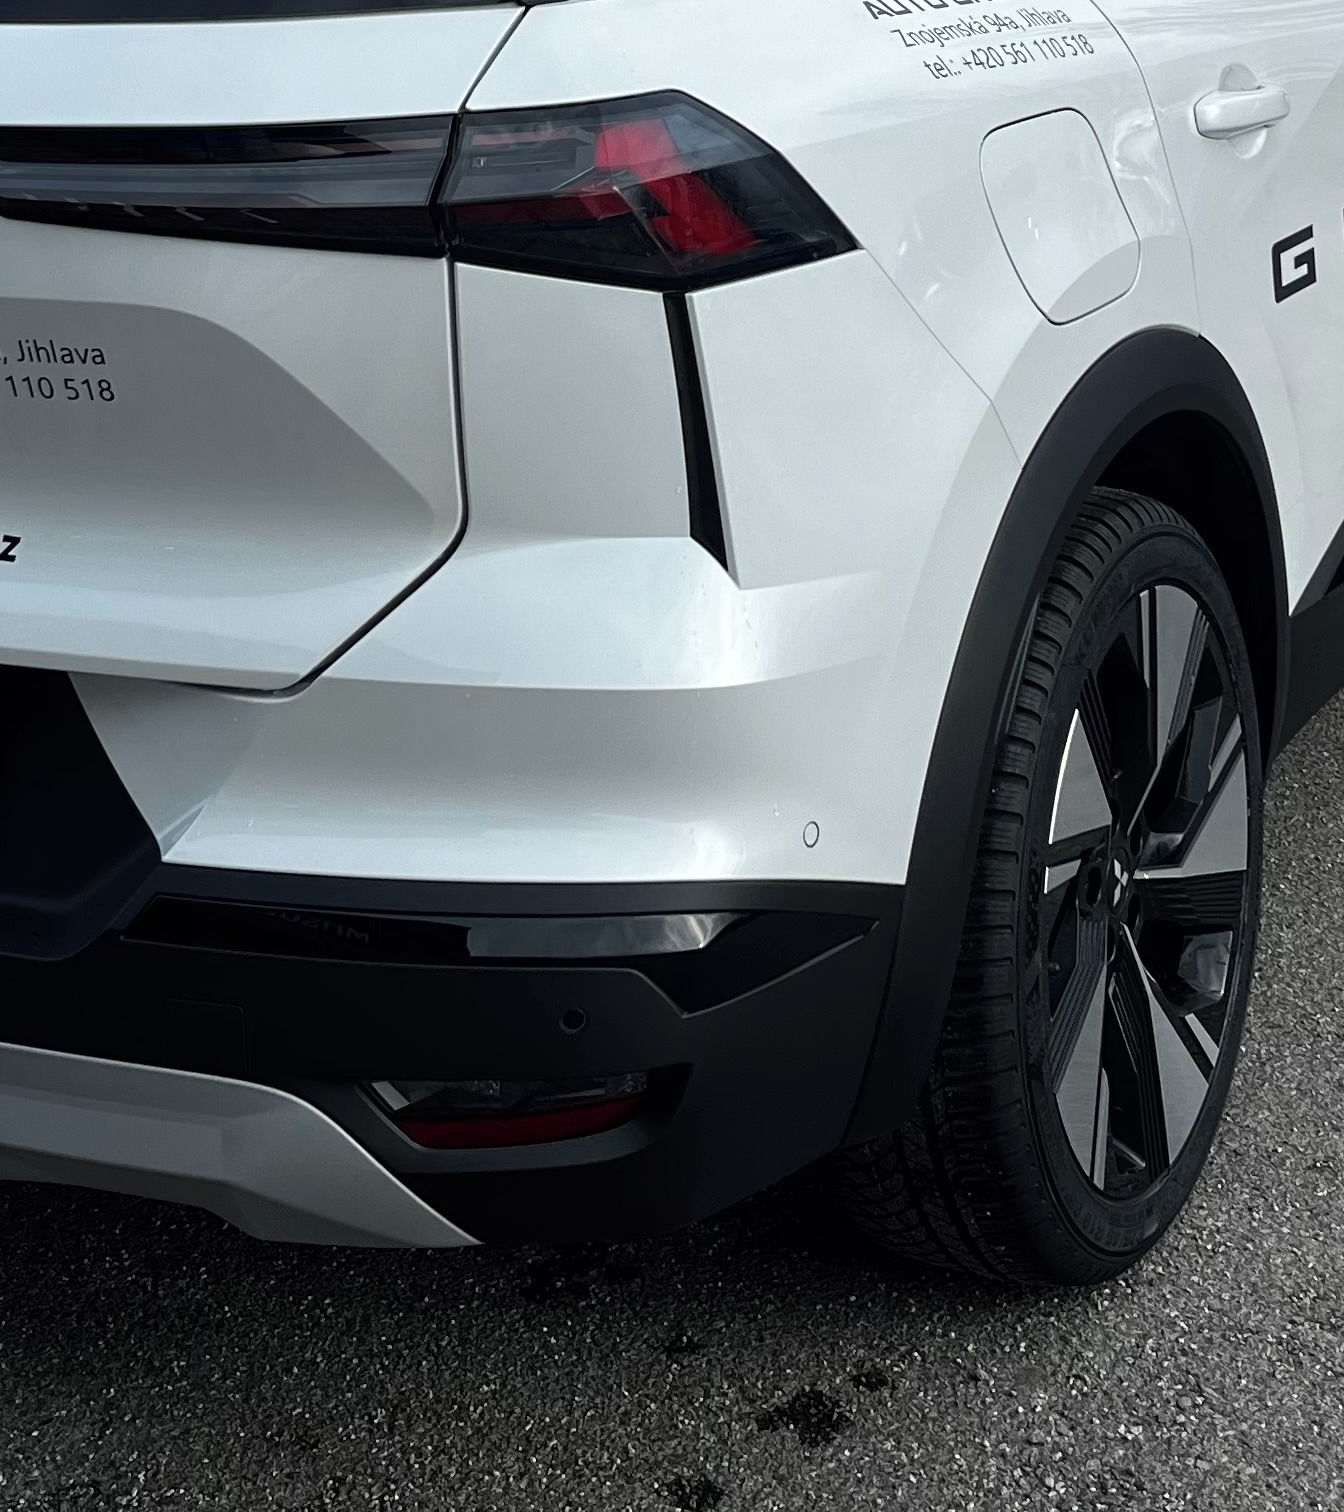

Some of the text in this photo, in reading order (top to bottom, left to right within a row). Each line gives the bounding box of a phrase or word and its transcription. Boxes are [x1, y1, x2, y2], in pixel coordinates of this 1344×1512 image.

[890, 8, 1072, 49] Znojemská 94a, Jihlava
[923, 33, 1094, 80] tel.: +420 561 110 518
[17, 339, 106, 366] Jihlava
[5, 374, 55, 400] 110
[63, 377, 115, 402] 518
